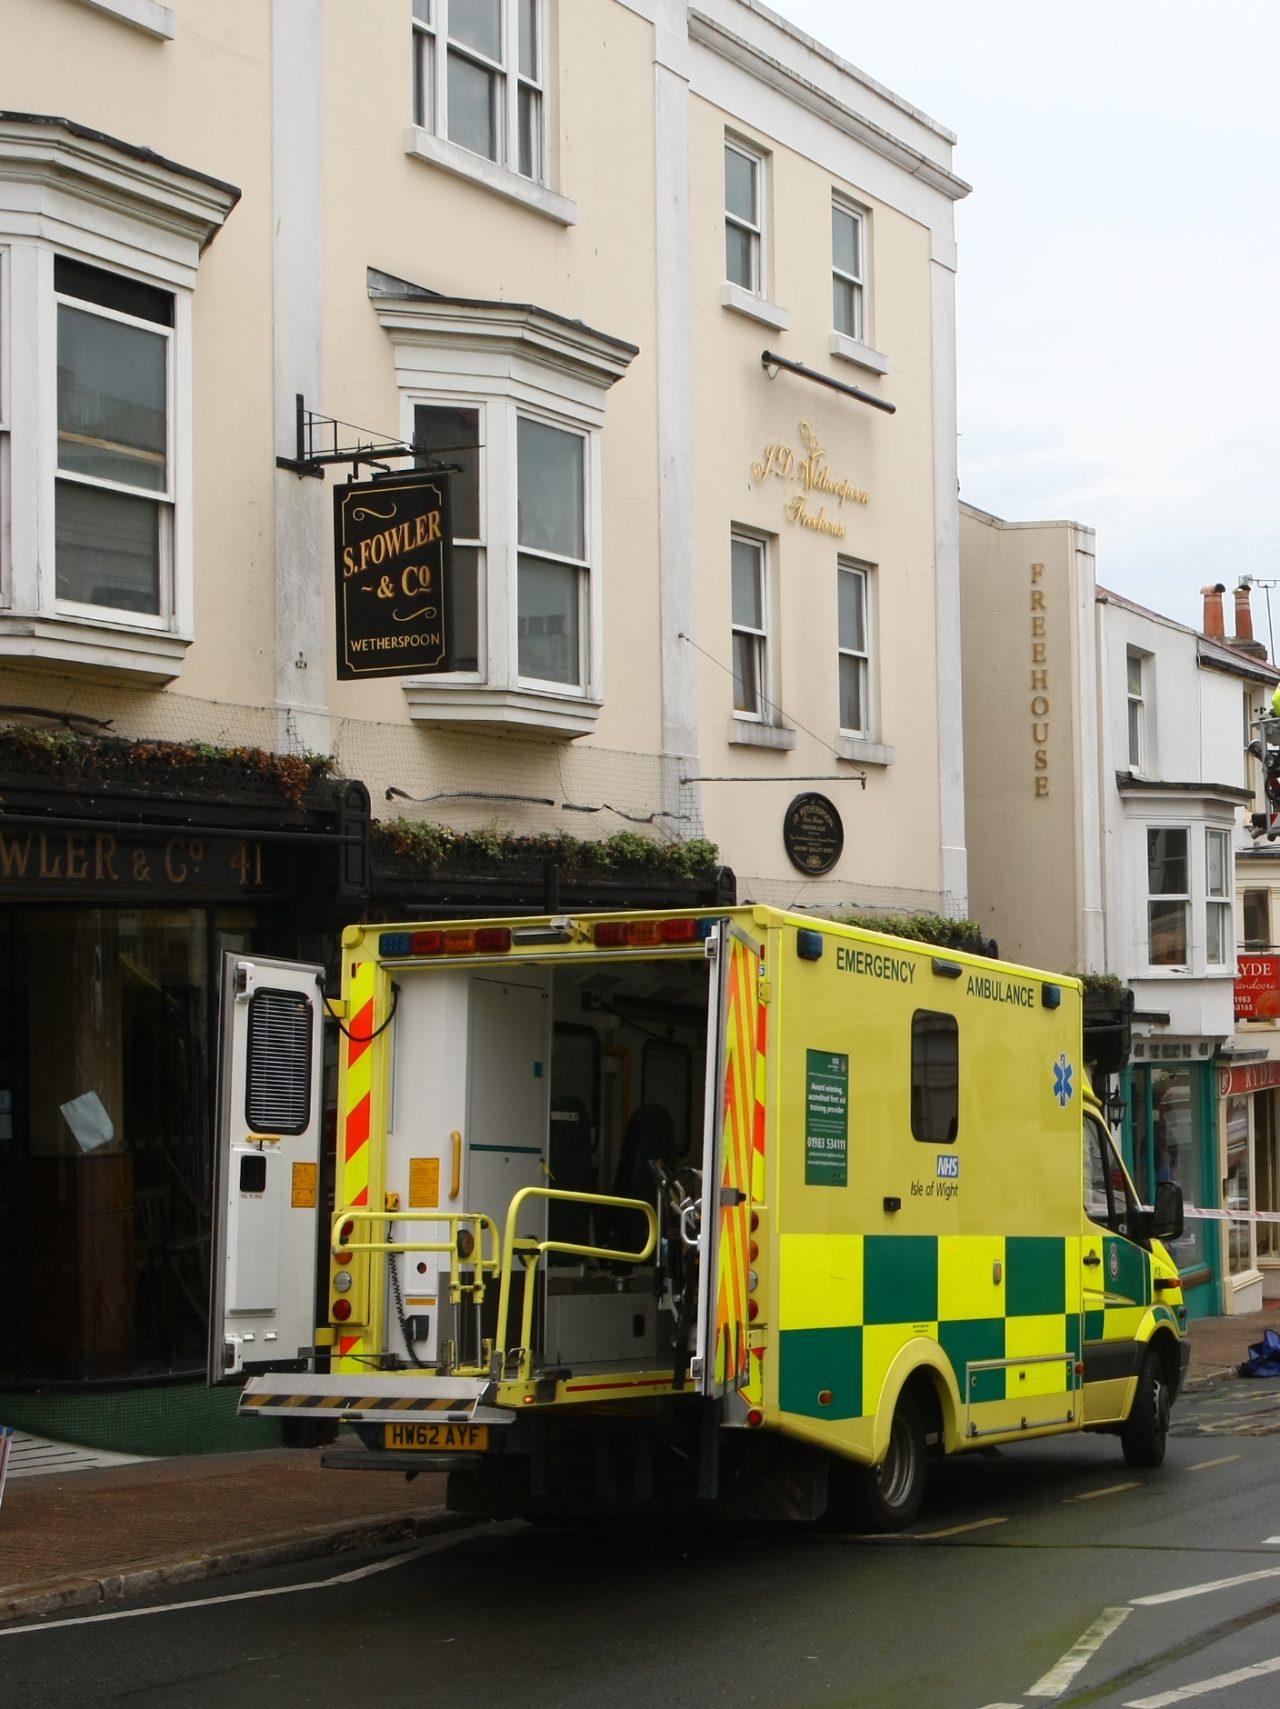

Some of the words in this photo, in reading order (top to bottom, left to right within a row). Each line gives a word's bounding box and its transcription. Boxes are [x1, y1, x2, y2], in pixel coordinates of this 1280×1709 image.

[377, 575, 395, 599] &
[350, 633, 440, 652] WETHERSPOON
[132, 848, 152, 881] &
[230, 841, 263, 885] 41
[836, 947, 916, 985] EMERGENCY
[966, 975, 1035, 1008] AMBULANCE
[1235, 977, 1277, 990] andoori
[1245, 1061, 1275, 1088] RYDE
[807, 1136, 825, 1148] 01983
[937, 1156, 958, 1176] NHS
[911, 1180, 923, 1196] Isle
[926, 1181, 934, 1196] of
[937, 1181, 958, 1200] Wight
[392, 1425, 440, 1445] HW62
